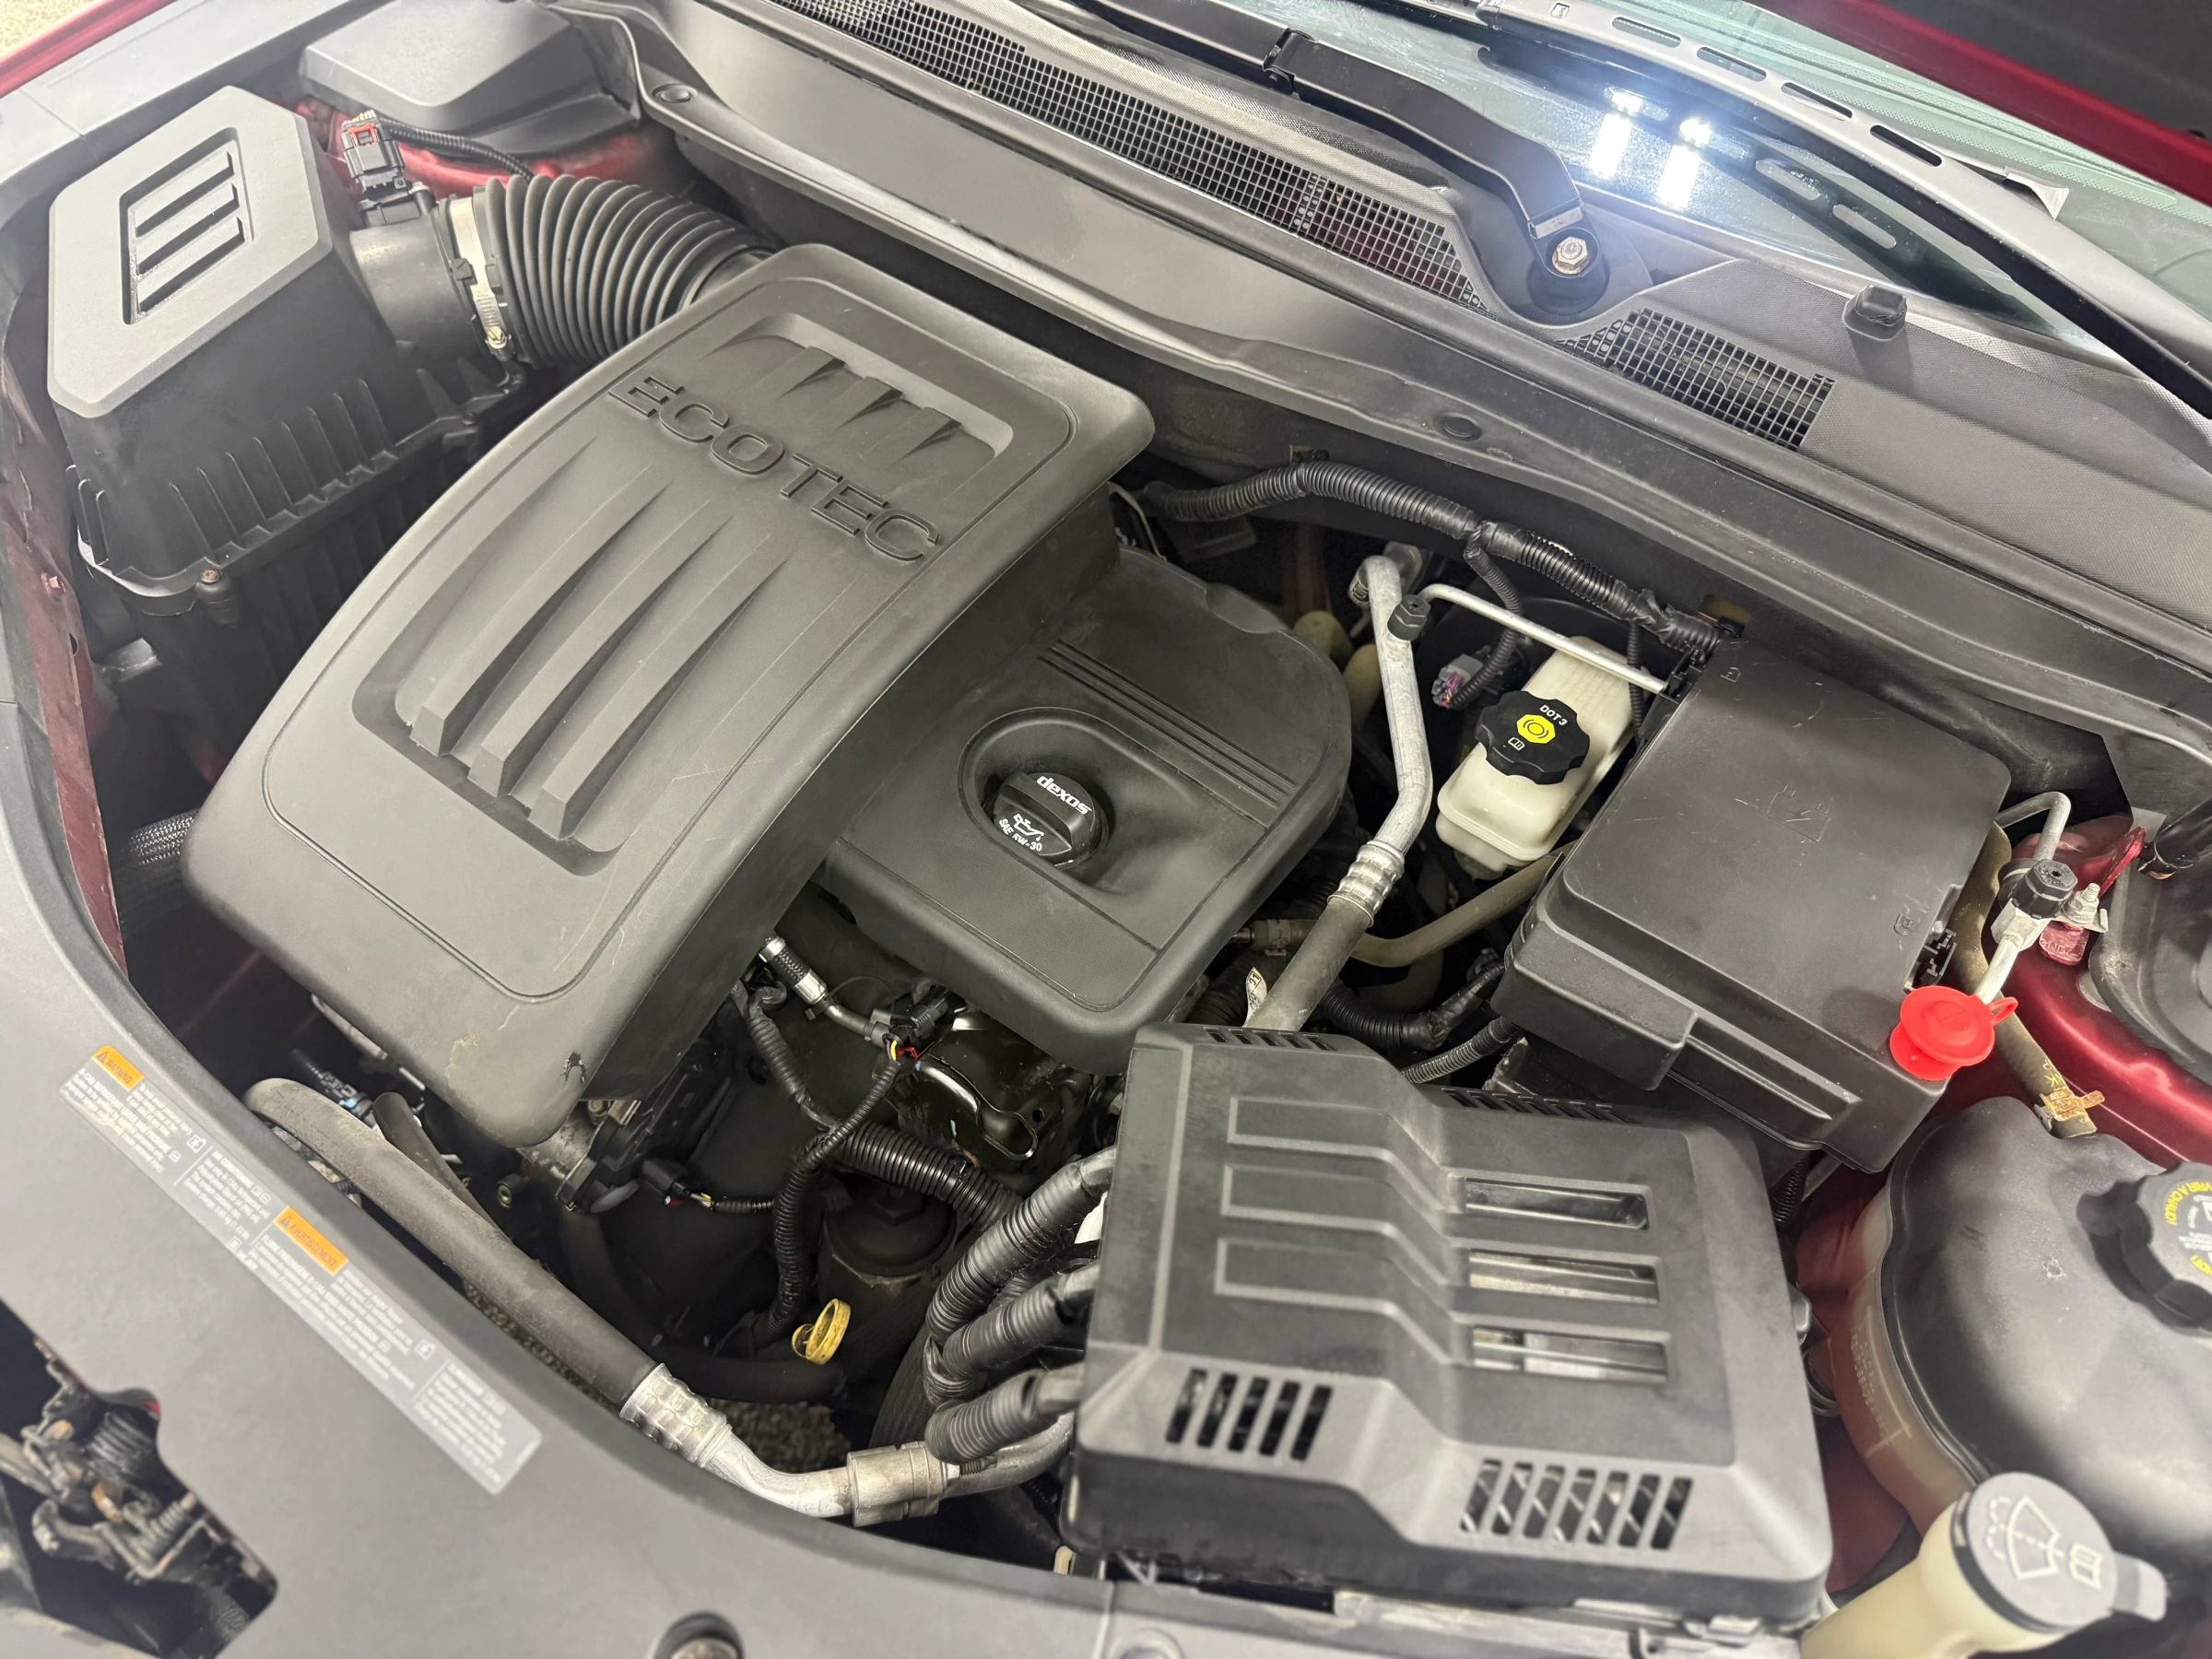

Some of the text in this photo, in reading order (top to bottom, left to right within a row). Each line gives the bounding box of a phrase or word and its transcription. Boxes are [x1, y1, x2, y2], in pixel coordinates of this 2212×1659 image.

[608, 375, 941, 563] ECOTEC
[1036, 775, 1093, 815] dexos
[999, 818, 1015, 835] SAE
[104, 1057, 133, 1084] WARNING
